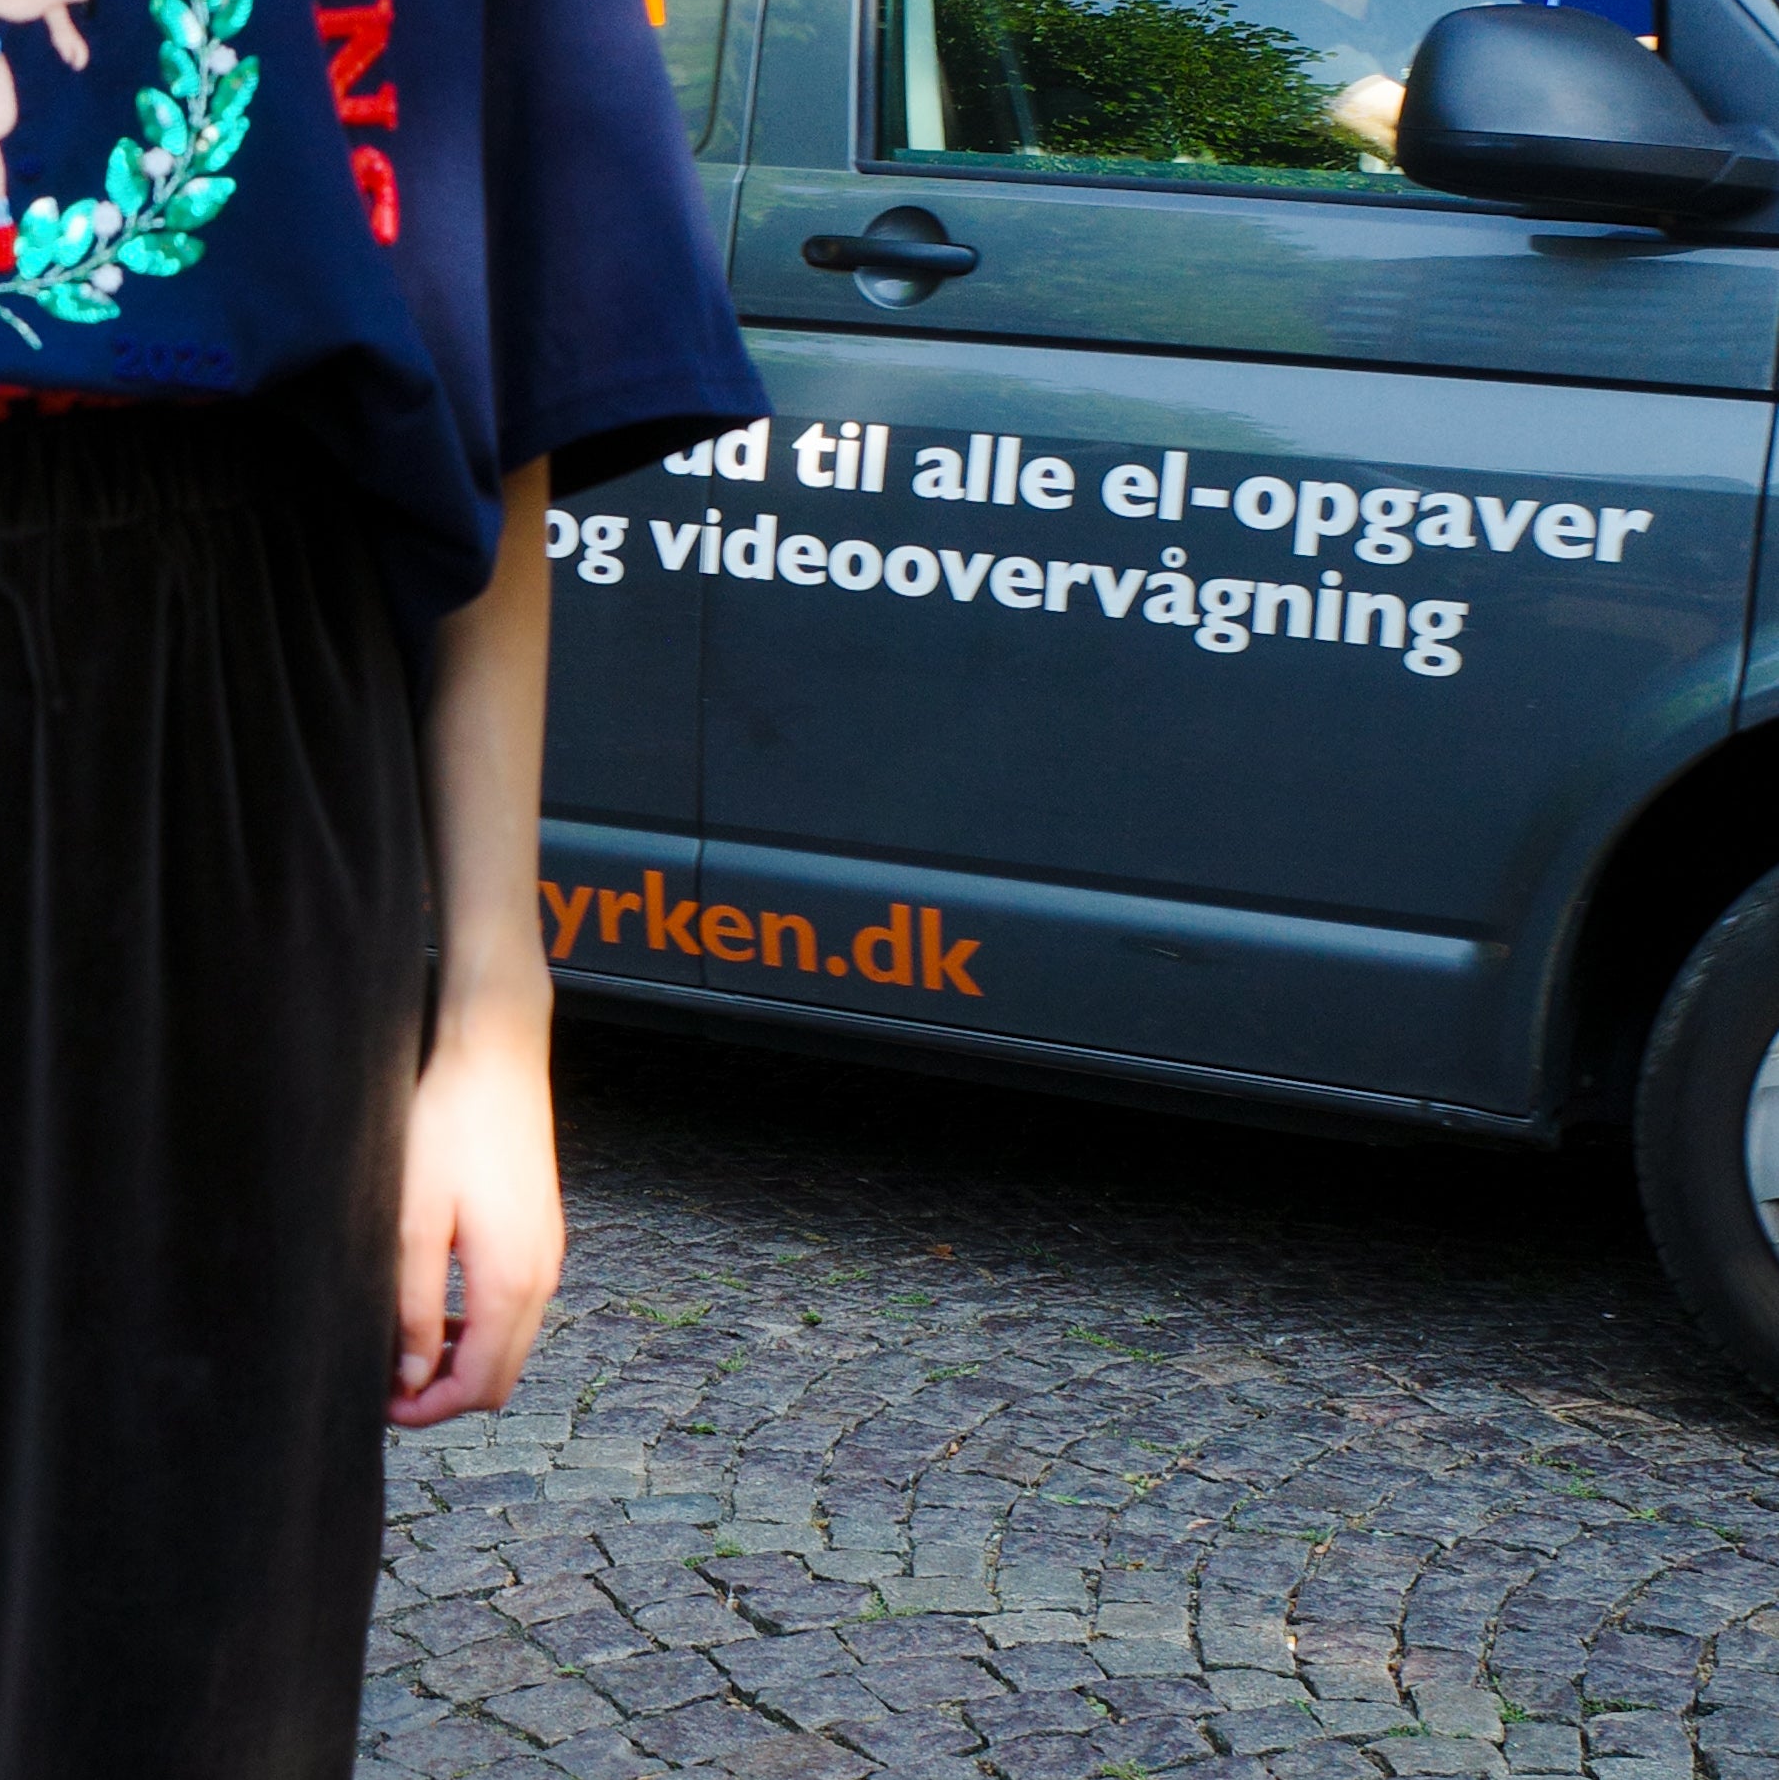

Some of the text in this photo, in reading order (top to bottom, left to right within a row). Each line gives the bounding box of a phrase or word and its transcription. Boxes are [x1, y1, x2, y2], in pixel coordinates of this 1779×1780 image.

[792, 421, 890, 493] til
[911, 432, 1076, 511] alle
[1100, 450, 1654, 566] el-opgaver
[545, 507, 1470, 678] og videoovervågning
